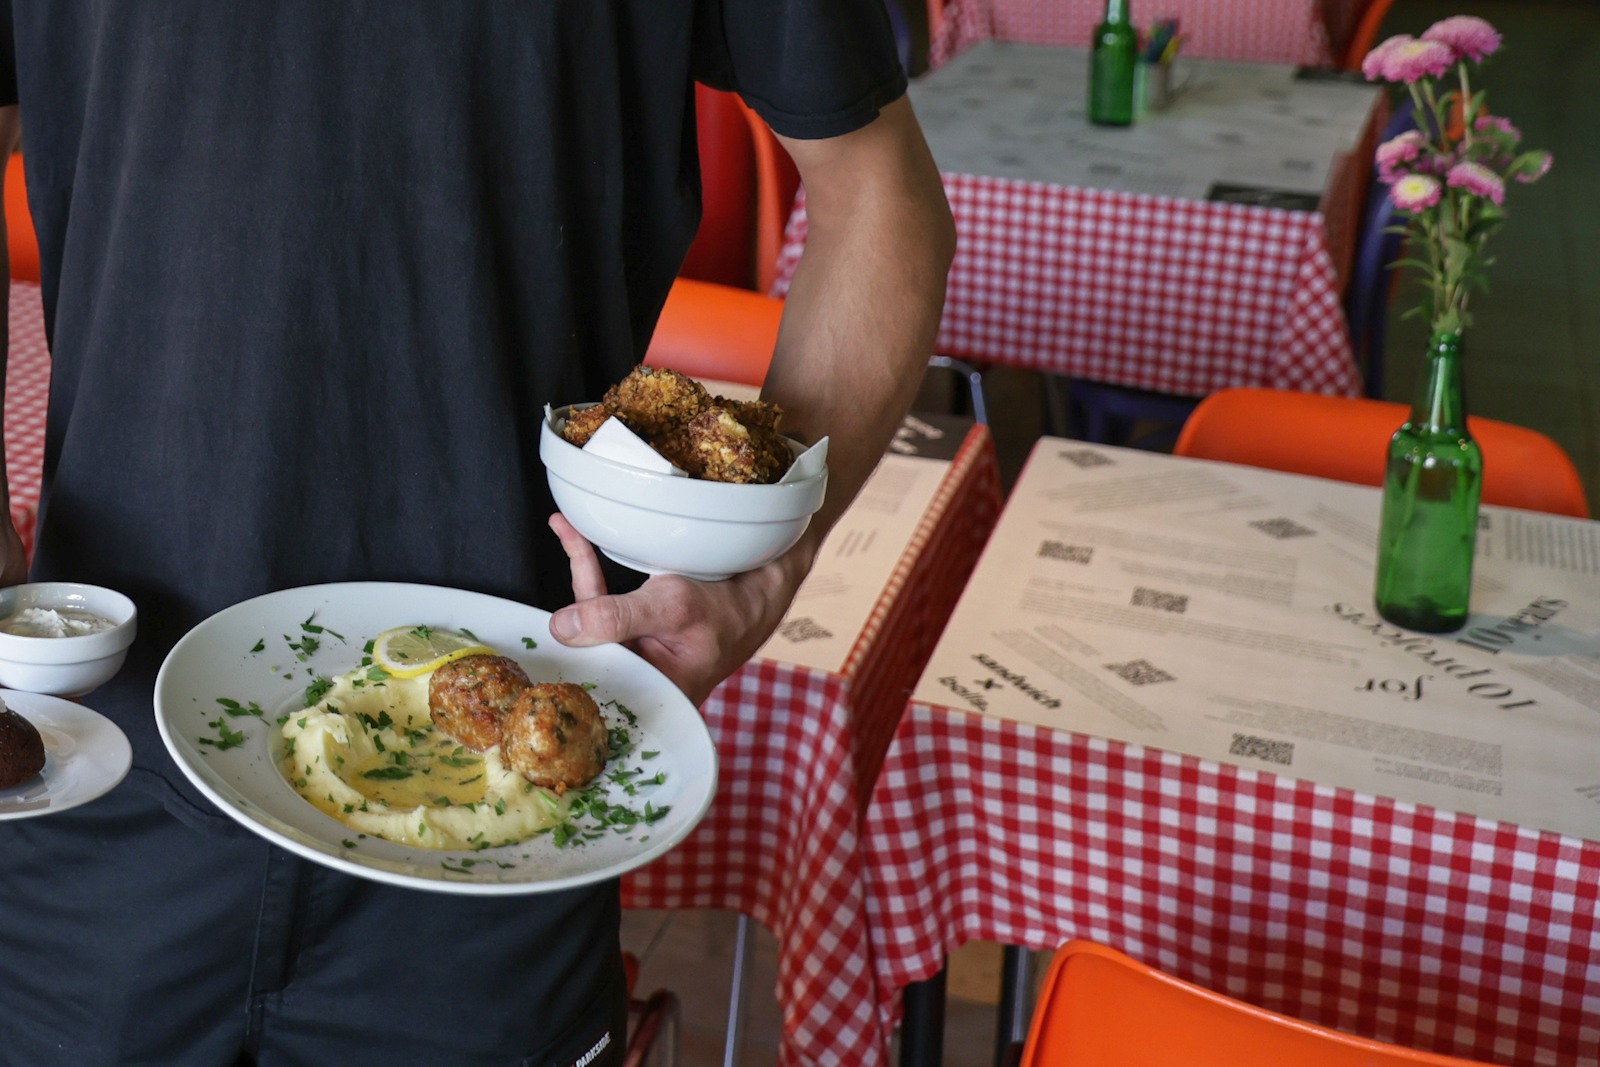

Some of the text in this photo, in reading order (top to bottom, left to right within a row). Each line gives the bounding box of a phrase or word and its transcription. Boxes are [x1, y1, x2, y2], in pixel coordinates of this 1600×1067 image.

[1456, 625, 1515, 656] 10
[970, 653, 1062, 710] sandwich
[1354, 673, 1435, 702] for
[1466, 682, 1539, 711] 10
[575, 1031, 612, 1067] PARKSIDE
